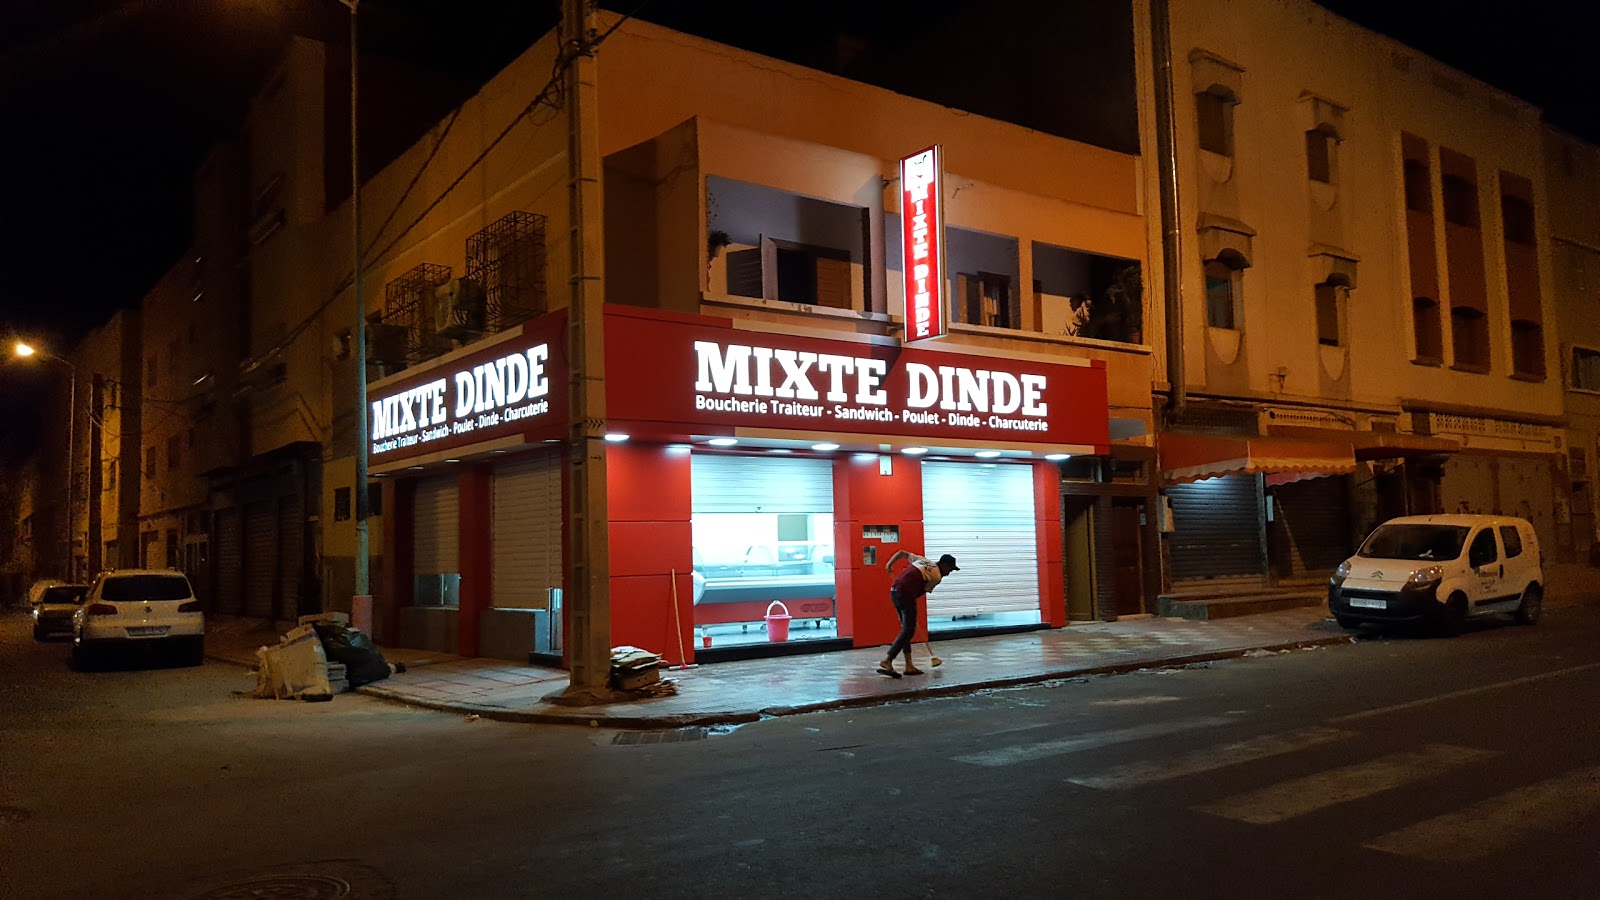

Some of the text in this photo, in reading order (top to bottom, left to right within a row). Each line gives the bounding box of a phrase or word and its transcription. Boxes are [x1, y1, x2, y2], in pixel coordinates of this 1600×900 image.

[913, 264, 930, 337] DINDE
[372, 343, 549, 441] MIXTE DINDE
[694, 341, 1048, 417] MIXTE DINDE
[695, 395, 768, 414] Boucherie
[770, 400, 824, 417] Traiteur
[835, 405, 893, 422] Sandwich
[902, 410, 940, 425] Poulet
[949, 413, 980, 427] Dinde
[989, 416, 1049, 431] Charcuterie
[372, 440, 398, 454] Boucherie
[398, 434, 419, 448] Traiteur
[422, 424, 449, 442] Sandwich
[453, 419, 474, 435] Poulet
[479, 411, 499, 429] Dinde
[504, 398, 549, 422] Charcuterie
